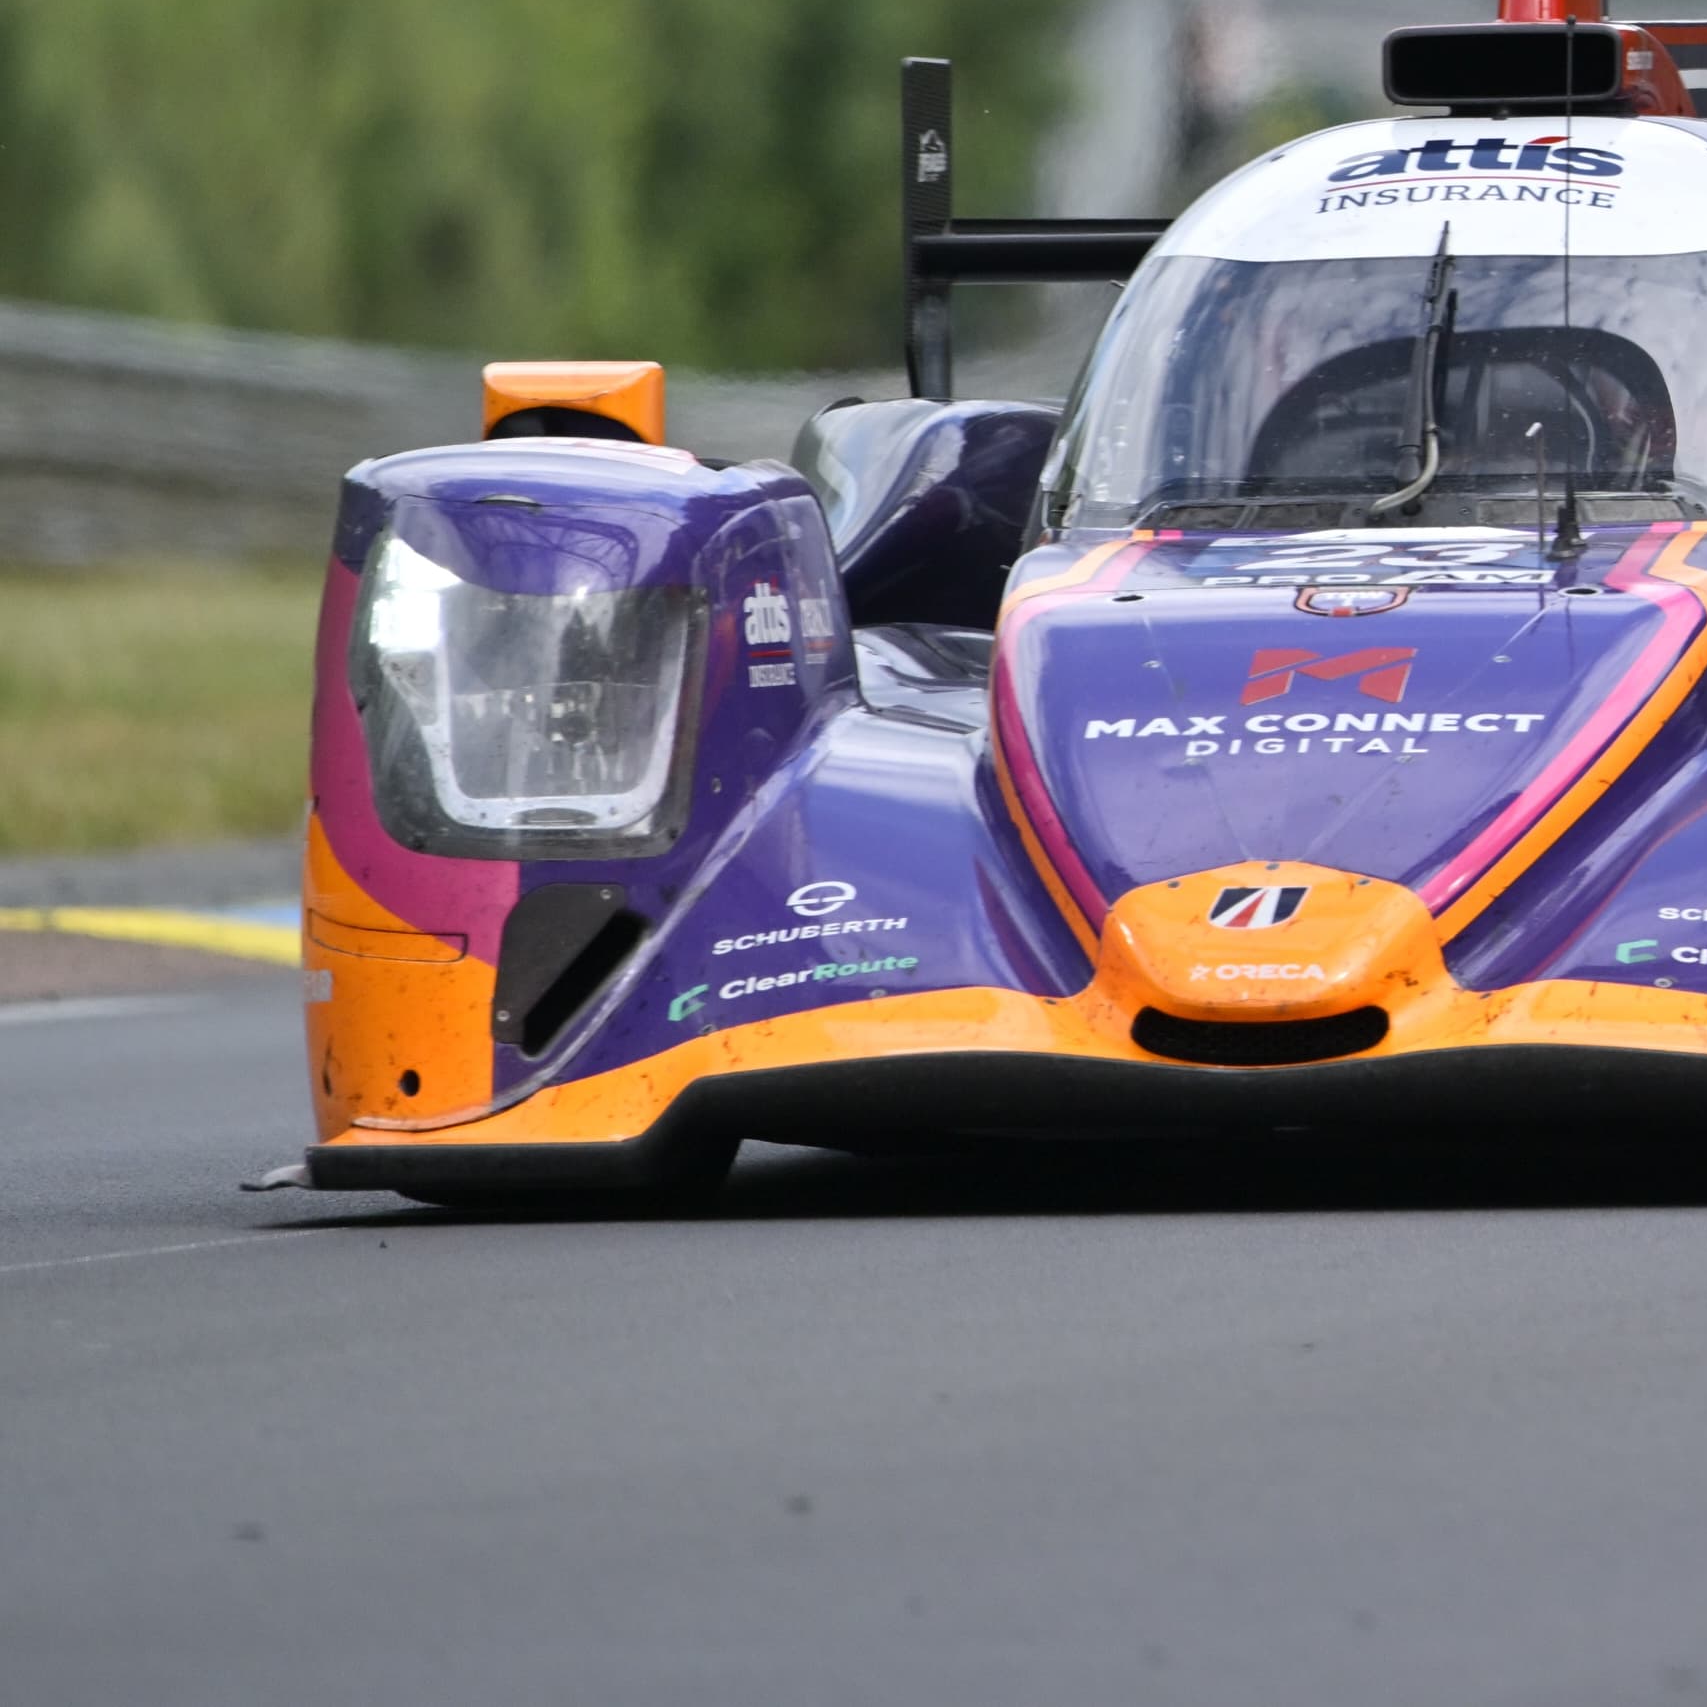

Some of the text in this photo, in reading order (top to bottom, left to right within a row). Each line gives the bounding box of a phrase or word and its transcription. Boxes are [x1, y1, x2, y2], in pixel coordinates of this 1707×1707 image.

[1327, 136, 1625, 182] attis
[1315, 184, 1617, 214] INSURANCE
[1235, 543, 1526, 571] 23
[1202, 574, 1372, 587] PRO
[1084, 712, 1545, 739] MAX CONNECT
[1184, 737, 1430, 757] DIGITAL
[711, 917, 908, 955] SCHUBERTH
[718, 956, 919, 1000] ClearRoute
[1215, 964, 1325, 981] ORECA
